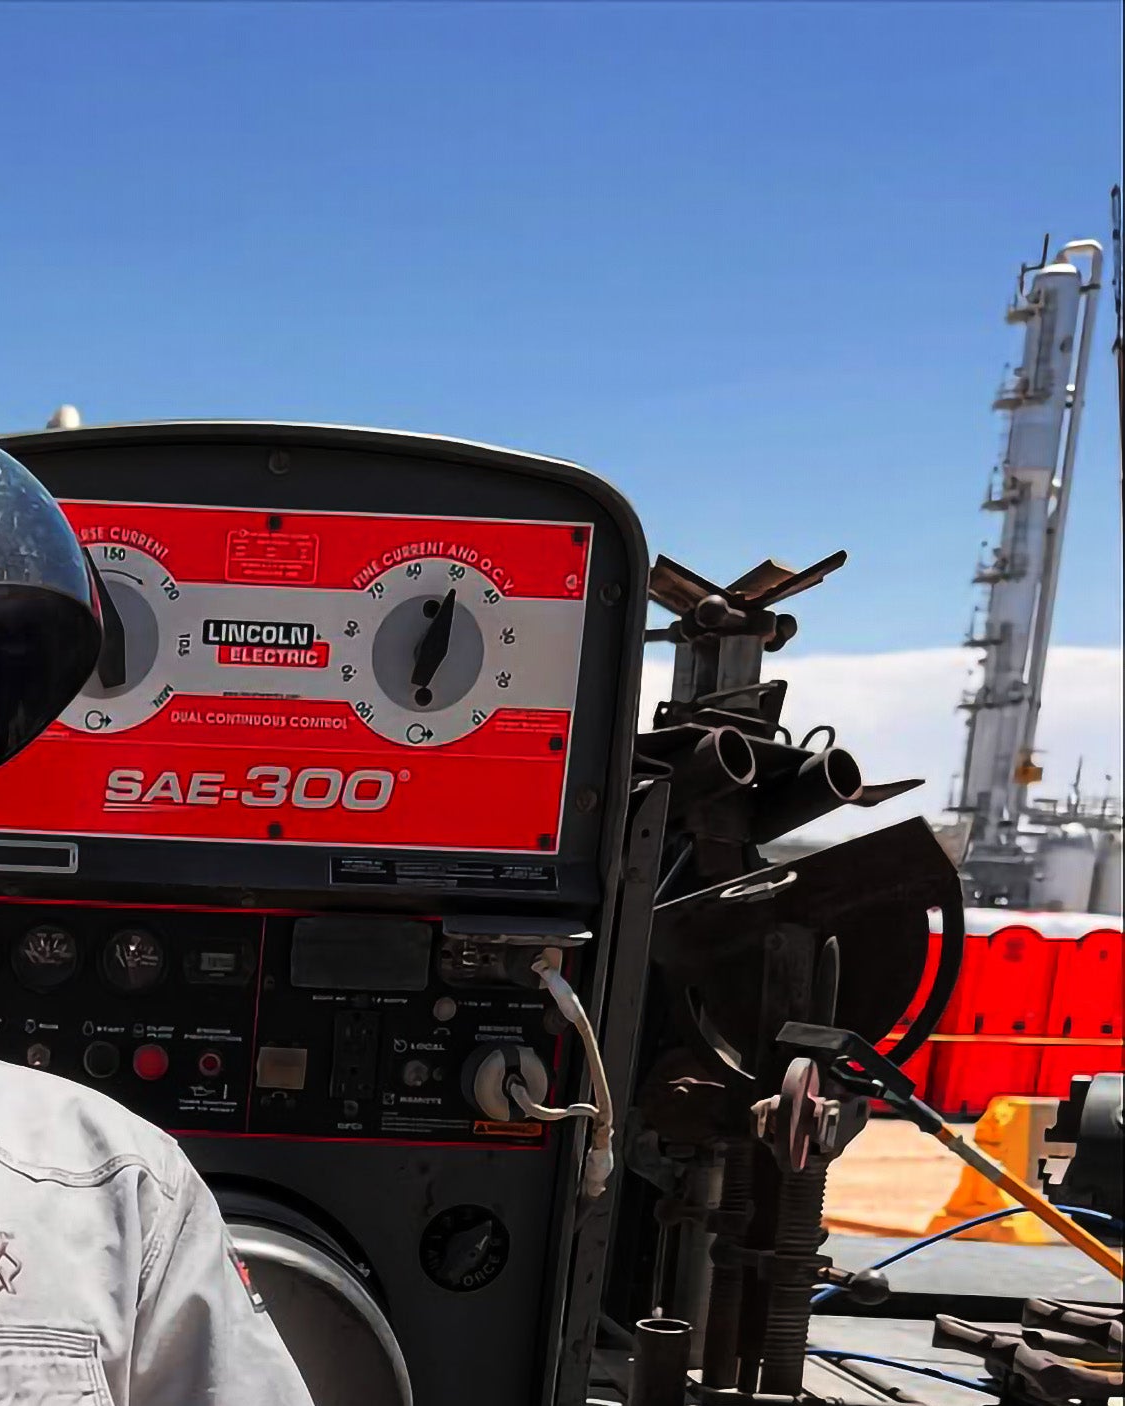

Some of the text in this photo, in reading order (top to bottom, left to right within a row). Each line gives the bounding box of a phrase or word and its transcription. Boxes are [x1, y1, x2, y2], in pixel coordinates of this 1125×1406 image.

[110, 527, 169, 559] CURRENT
[352, 562, 381, 588] FINE
[382, 542, 444, 566] CURRENT
[447, 544, 478, 564] AND
[448, 564, 465, 580] 50
[160, 576, 180, 601] 120
[208, 623, 309, 646] LINCOLN
[230, 647, 319, 665] ELECTRIC
[170, 710, 347, 730] DUAL CONTINUOUS CONTROL
[105, 765, 396, 812] SAE-300
